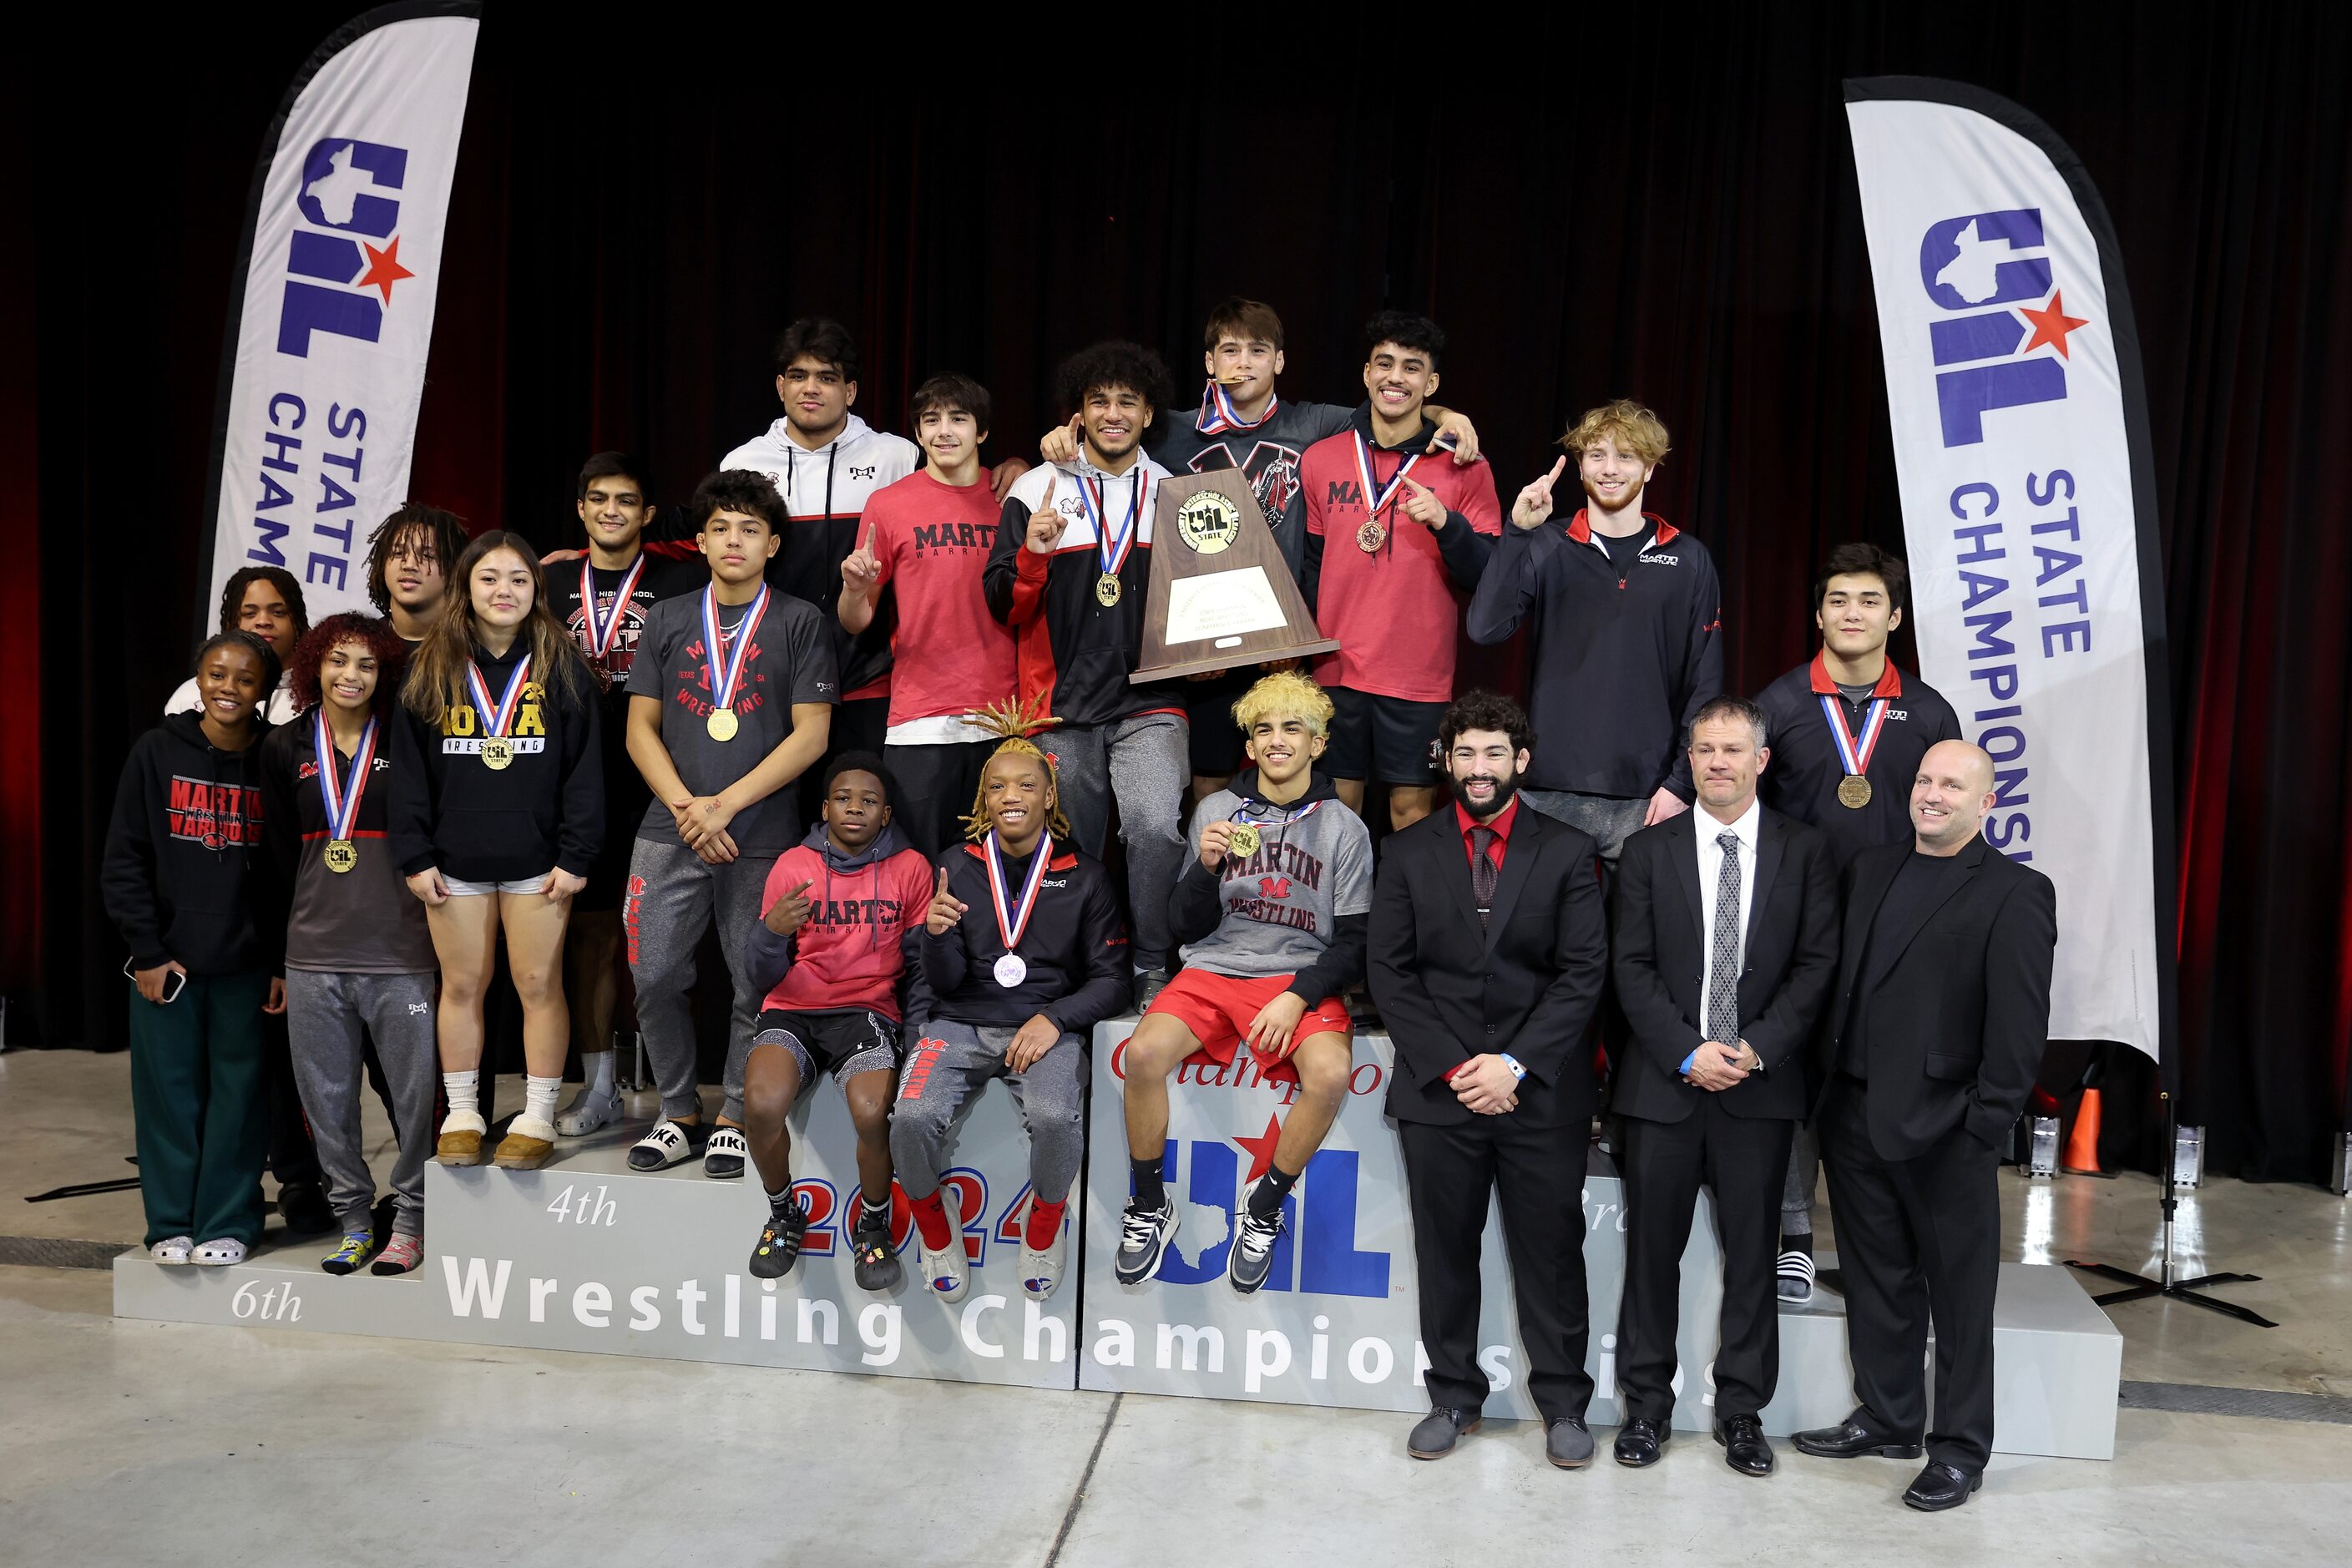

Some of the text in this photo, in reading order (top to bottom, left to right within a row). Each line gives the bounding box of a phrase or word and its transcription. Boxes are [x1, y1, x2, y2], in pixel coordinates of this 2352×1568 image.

[277, 138, 407, 359] UIL
[1920, 208, 2068, 448] UIL
[306, 402, 367, 591] STATE
[913, 524, 999, 550] MART
[1188, 507, 1227, 533] UIL
[1197, 532, 1222, 541] STATE
[916, 548, 992, 559] WARRI
[1639, 554, 1678, 564] MARTIN
[2026, 469, 2091, 658] STATE
[679, 671, 695, 680] TEXAS
[443, 704, 546, 736] IOA
[675, 688, 764, 718] WRESING
[448, 740, 539, 752] RESING
[170, 778, 264, 822] MARTIN
[1225, 842, 1323, 892] MARTIN
[627, 898, 641, 966] MARTIN
[800, 923, 900, 934] WARRIRS
[902, 1050, 941, 1100] MARTIN
[547, 1184, 618, 1227] 4th
[230, 1279, 303, 1323] 6th
[441, 1255, 903, 1367] Wrestling
